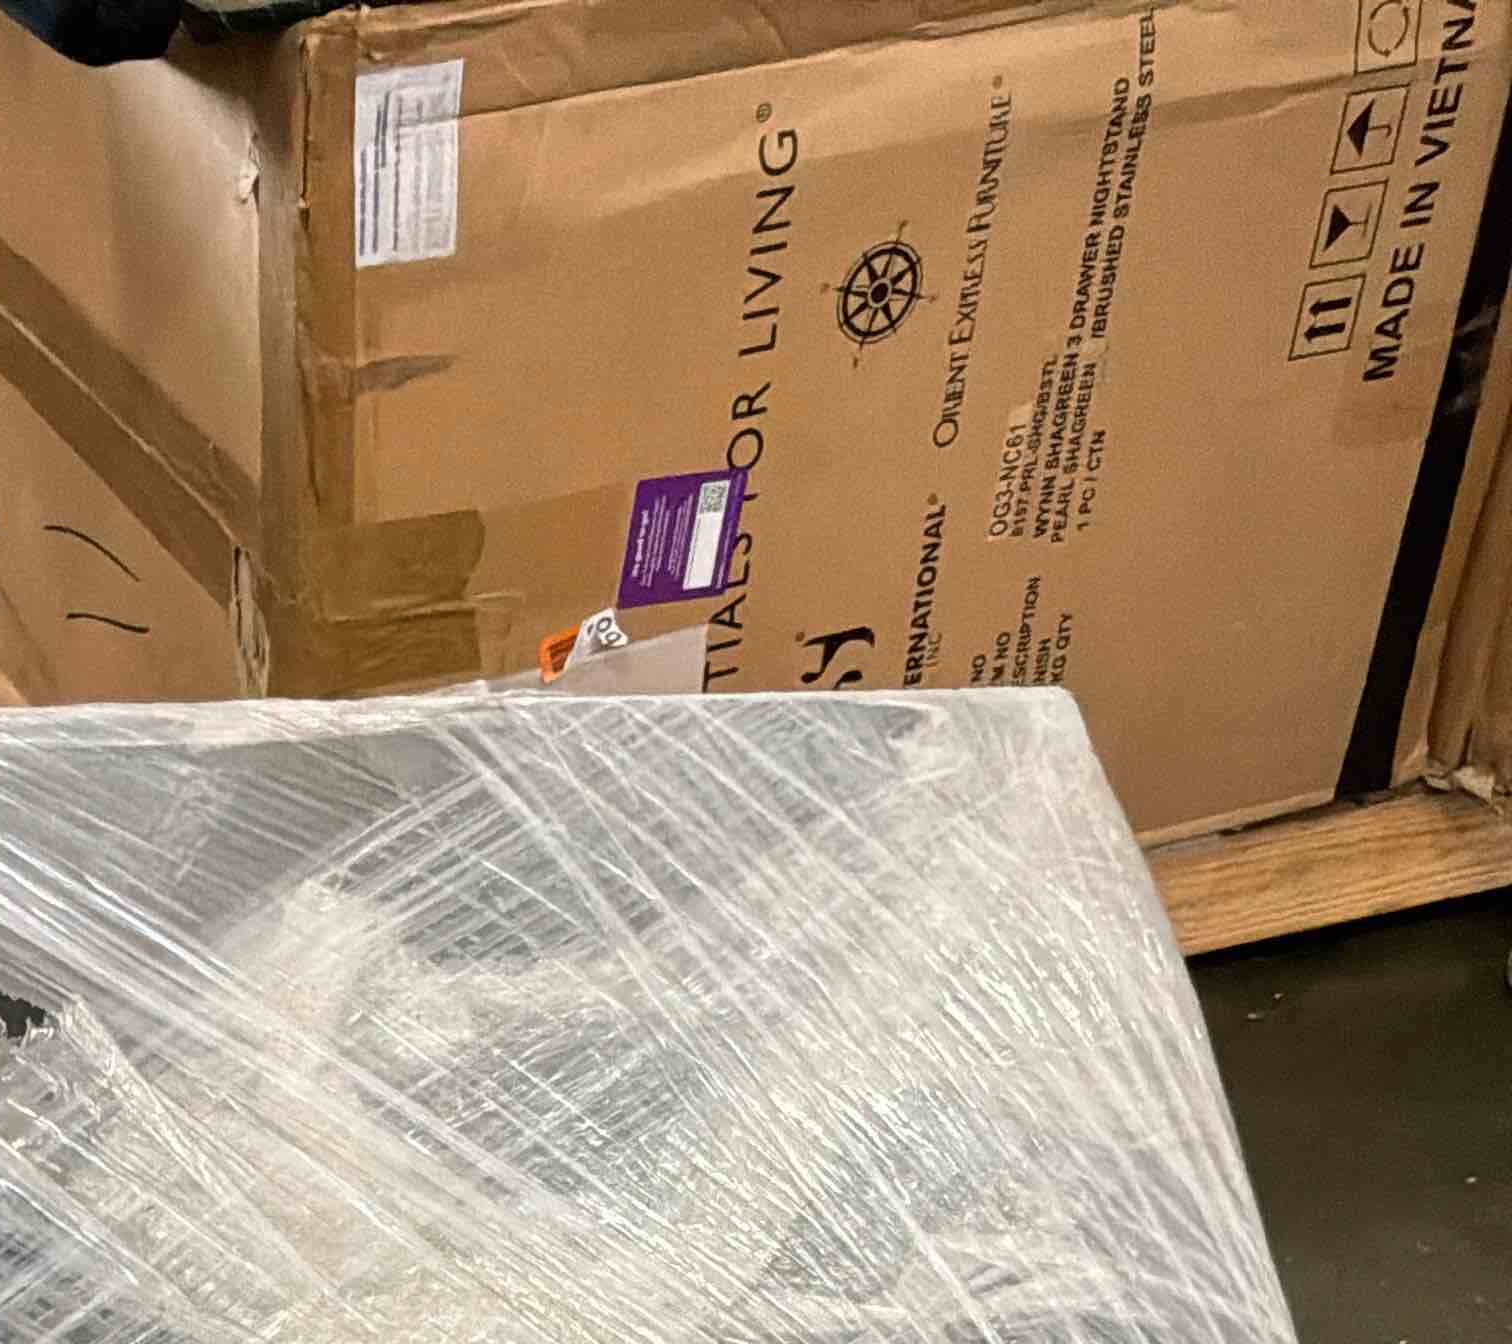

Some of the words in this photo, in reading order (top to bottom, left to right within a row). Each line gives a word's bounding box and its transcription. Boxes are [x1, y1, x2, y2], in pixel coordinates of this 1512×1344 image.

[1088, 77, 1131, 228] NIGHTSTAND
[948, 239, 988, 346] EXPRESS
[1050, 480, 1076, 543] PEARL
[1063, 361, 1097, 474] SHAGREEN
[1113, 94, 1153, 220] STAINLESS
[1138, 6, 1157, 88] STEEL
[1069, 231, 1101, 331] DRAWER
[1362, 242, 1425, 382] MADE
[1399, 180, 1440, 228] IN
[1066, 335, 1082, 349] 3
[933, 351, 969, 449] ORIENT
[1044, 351, 1080, 472] SHAGREEN
[1087, 430, 1106, 470] CTN
[1034, 476, 1057, 538] WYNN
[1077, 520, 1091, 532] 1
[1078, 482, 1097, 517] PC
[994, 631, 1011, 661] NO
[1056, 612, 1073, 652] QTY
